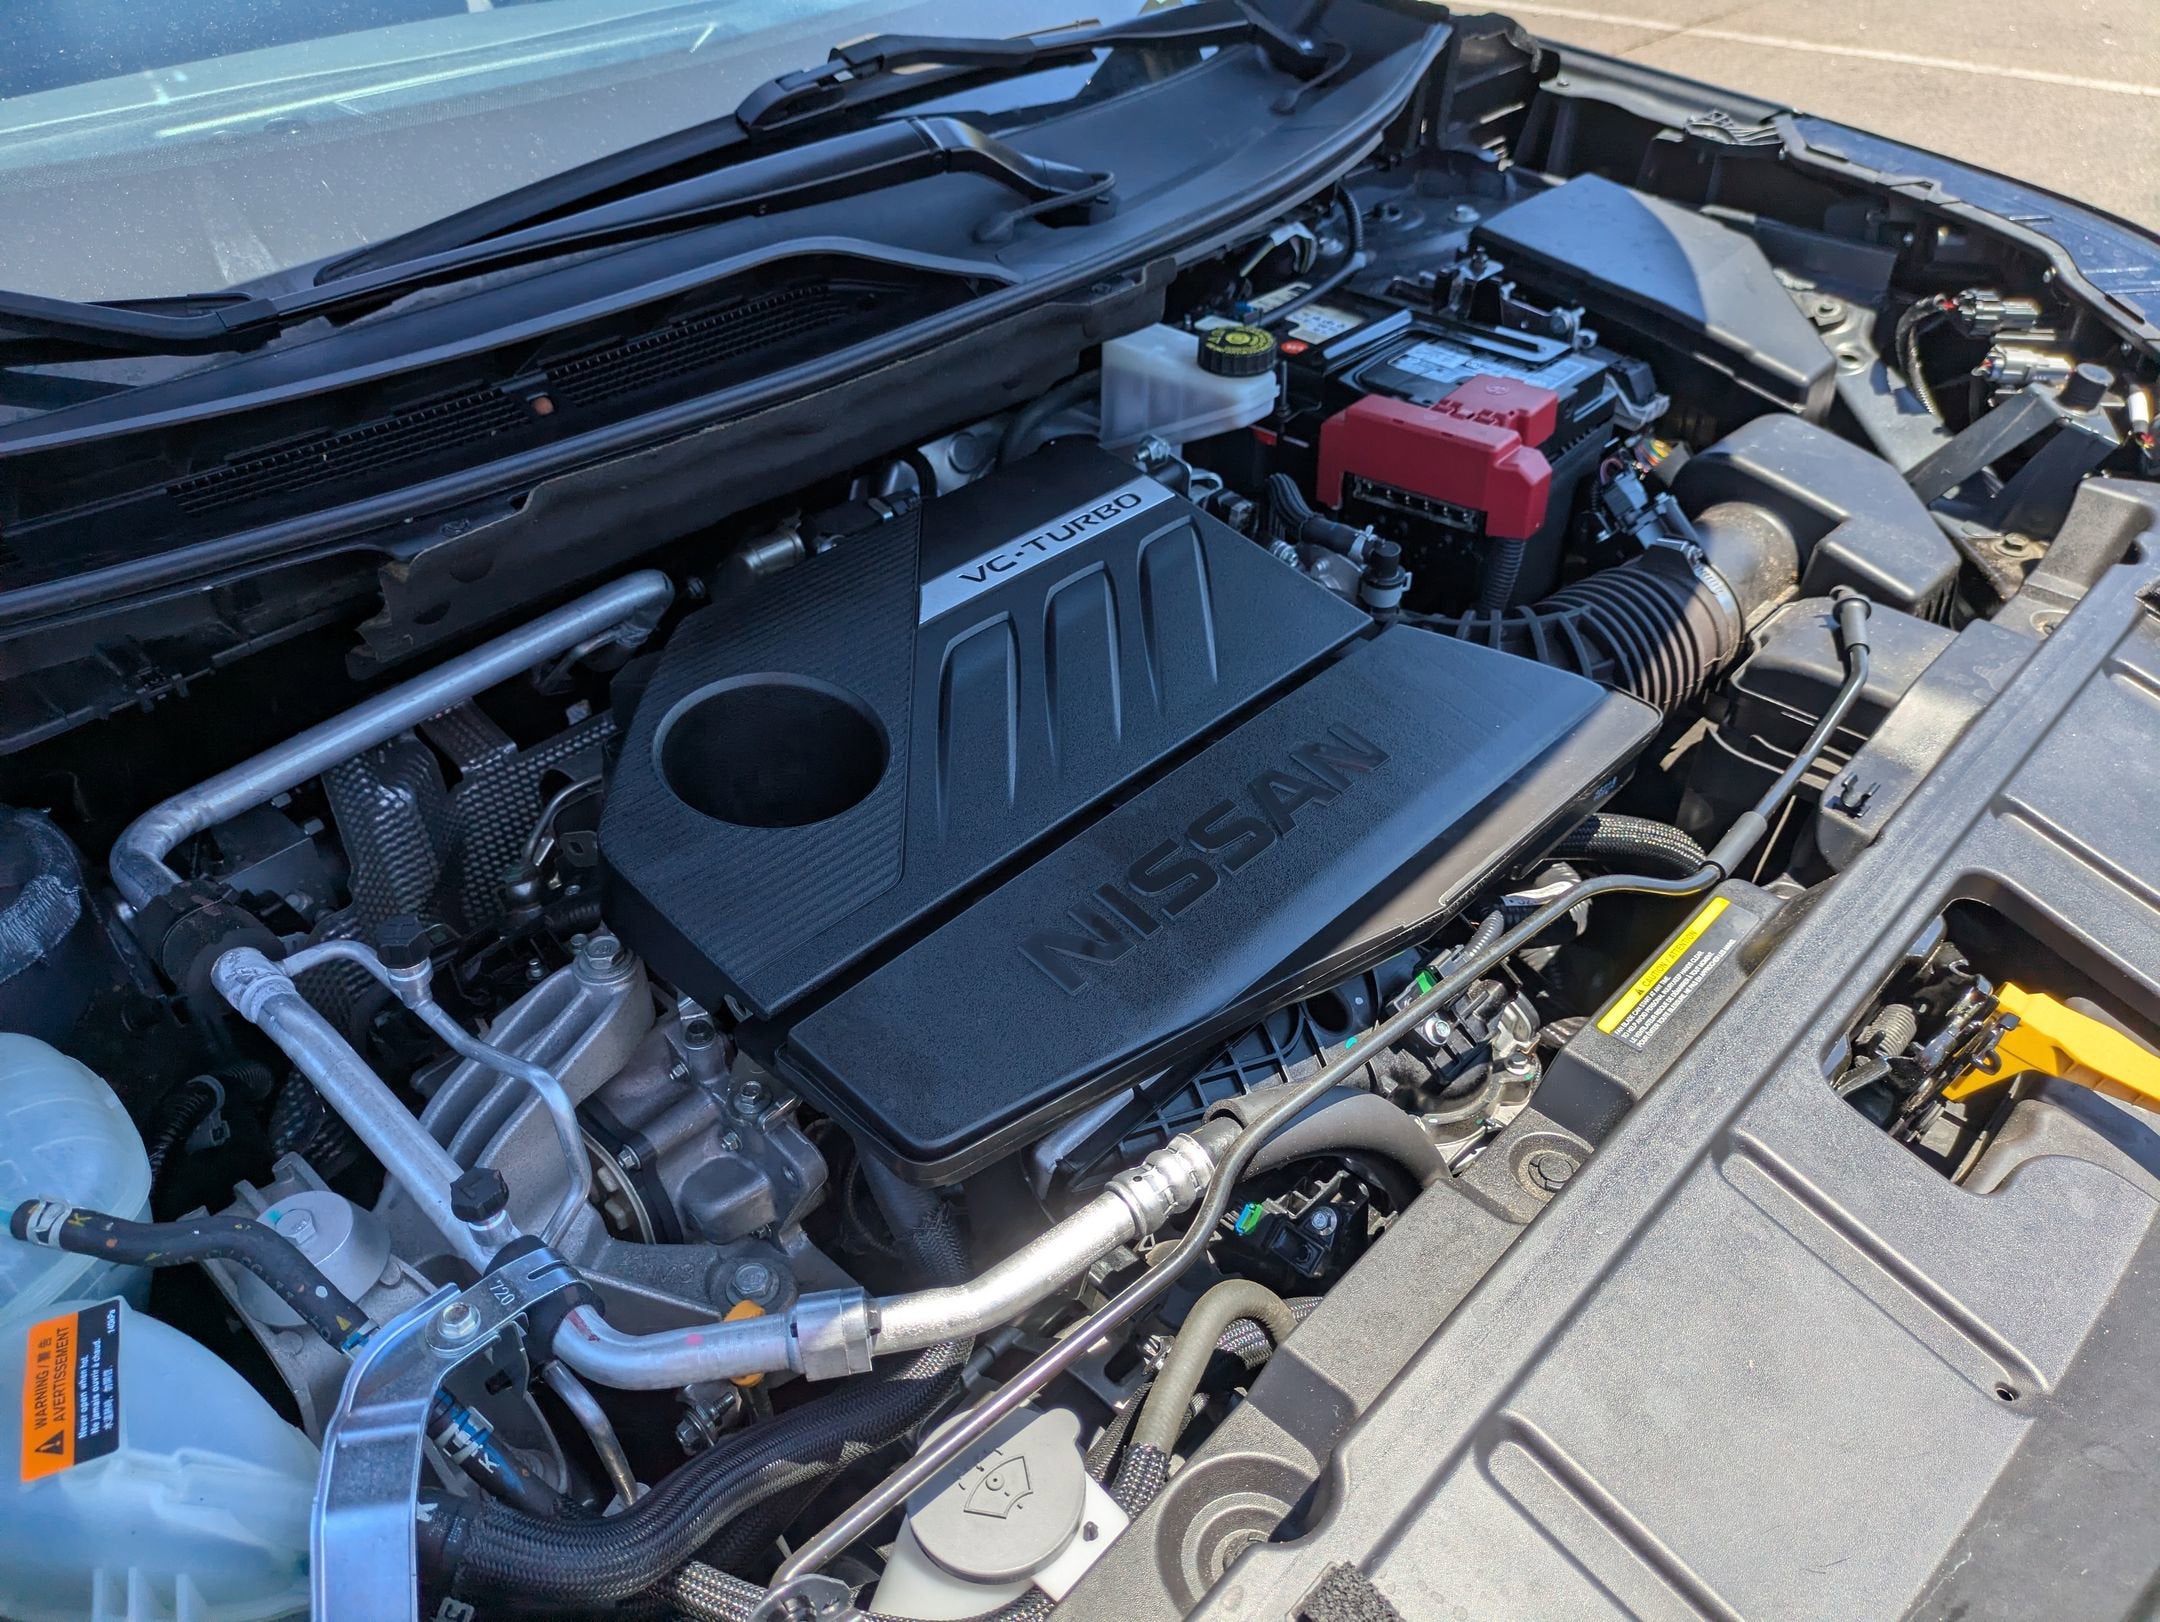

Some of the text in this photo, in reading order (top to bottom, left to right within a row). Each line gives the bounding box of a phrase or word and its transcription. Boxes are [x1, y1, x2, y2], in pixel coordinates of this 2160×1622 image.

[1016, 720, 1391, 997] NISSAN
[1642, 962, 1668, 987] CAUTION
[1667, 930, 1697, 959] ATTENTION
[1626, 1022, 1638, 1033] HELP
[490, 1280, 515, 1305] 720
[53, 1326, 70, 1422] AVERTISSEMENT
[79, 1369, 89, 1390] when
[92, 1369, 101, 1392] ouvrir
[34, 1371, 50, 1429] WARNING
[80, 1391, 89, 1413] open
[92, 1394, 102, 1420] jamais
[78, 1414, 88, 1439] Never
[91, 1421, 100, 1434] Ne
[478, 1452, 500, 1474] K
